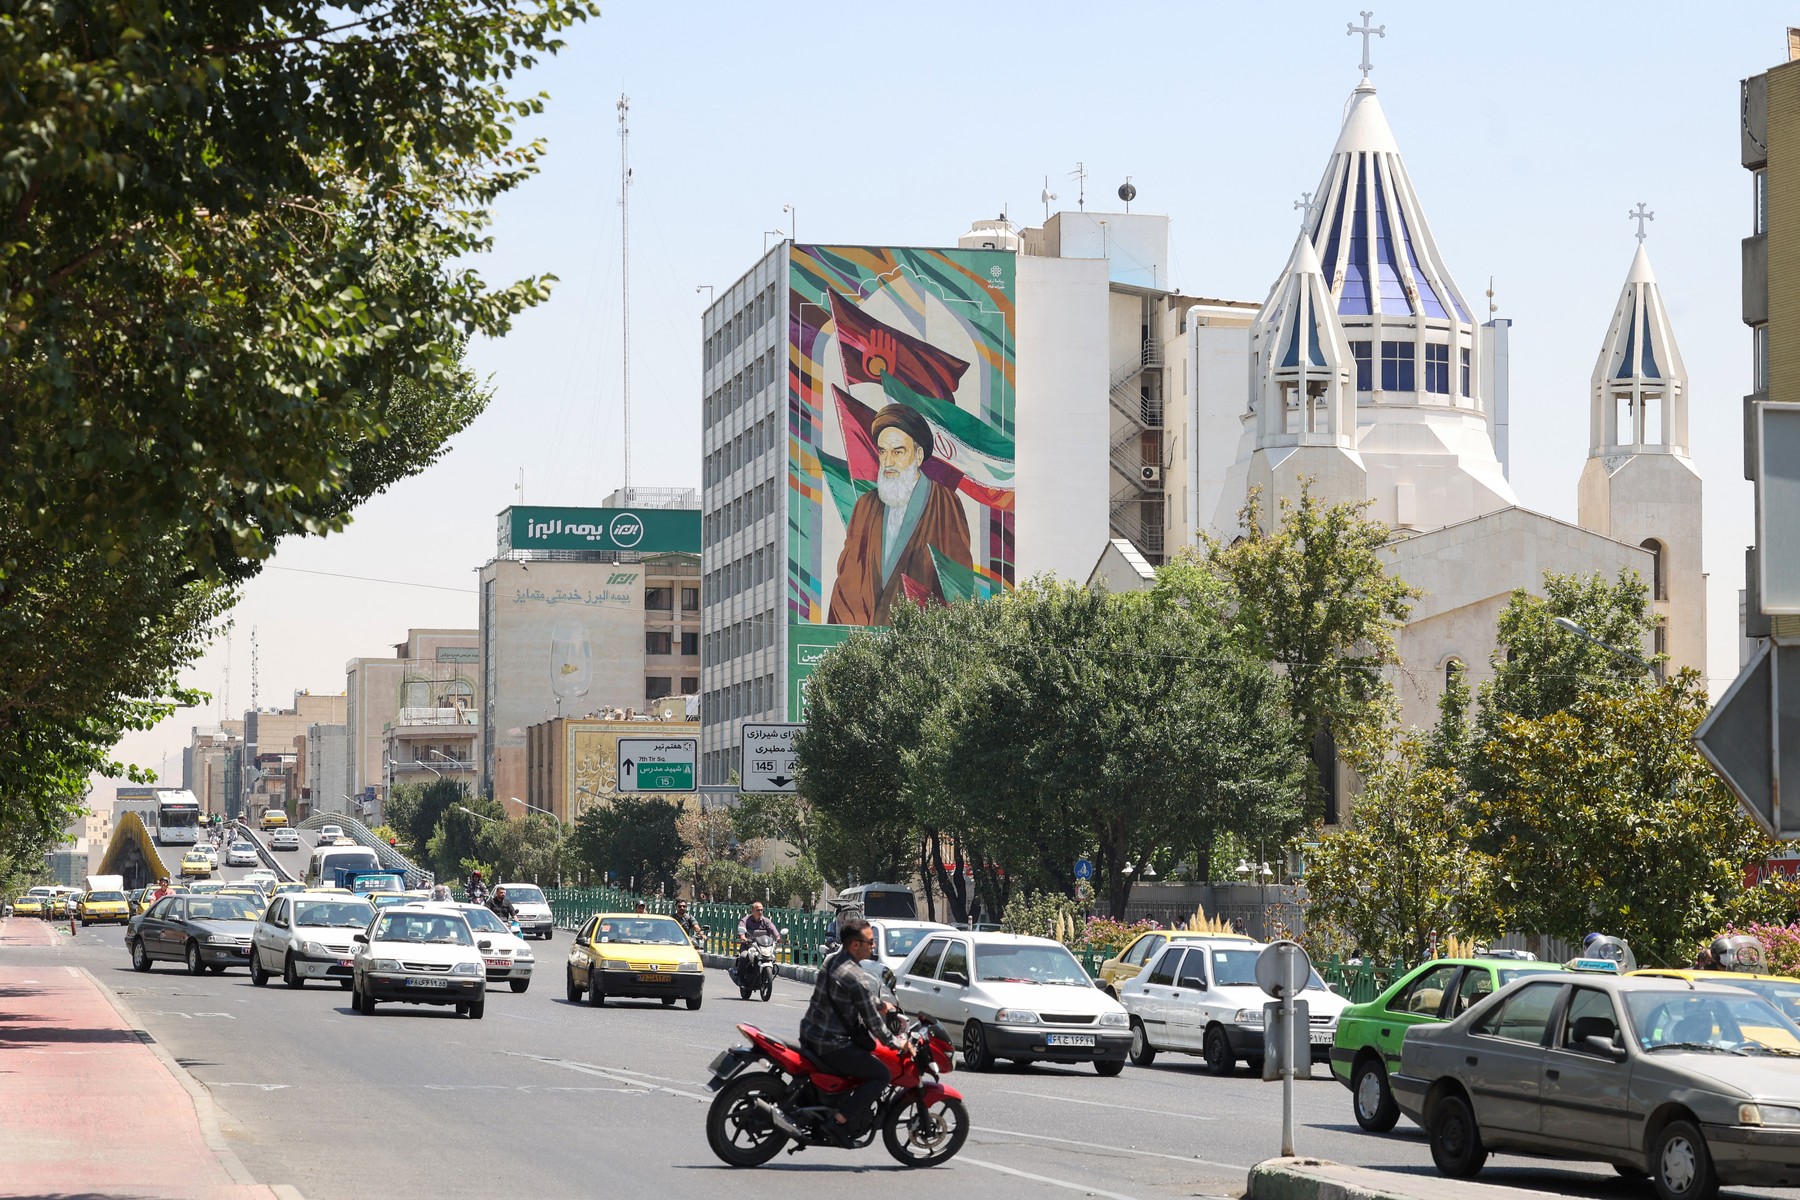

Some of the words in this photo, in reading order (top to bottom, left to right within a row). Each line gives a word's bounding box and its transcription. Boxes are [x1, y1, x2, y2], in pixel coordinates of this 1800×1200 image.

[528, 518, 562, 540] البرز
[564, 524, 603, 541] بیمه
[512, 588, 545, 603] متمایز
[546, 589, 582, 604] خدمتی
[584, 590, 609, 604] البرز
[611, 592, 631, 603] بیمه
[746, 730, 779, 740] شیرازی
[653, 743, 665, 751] تیر
[665, 742, 682, 752] هفتم
[755, 745, 786, 754] مطهری
[639, 766, 663, 774] مدرس
[664, 765, 682, 773] شهید
[755, 761, 774, 771] 145
[661, 777, 670, 786] 15
